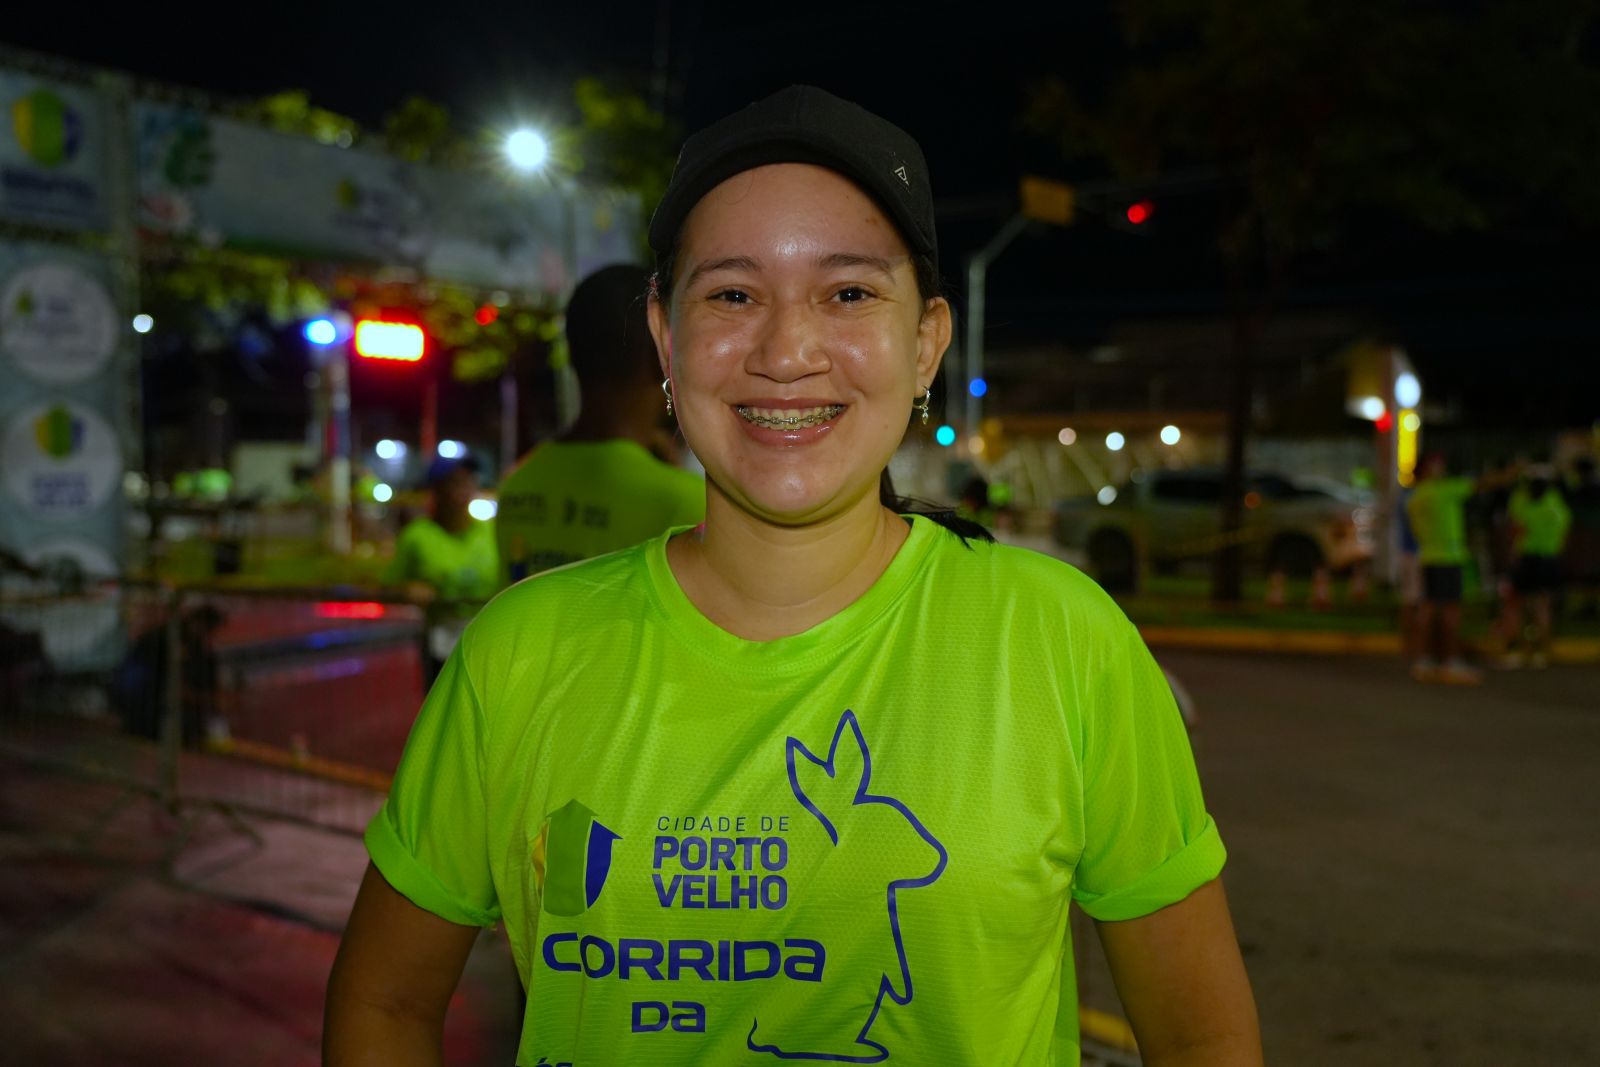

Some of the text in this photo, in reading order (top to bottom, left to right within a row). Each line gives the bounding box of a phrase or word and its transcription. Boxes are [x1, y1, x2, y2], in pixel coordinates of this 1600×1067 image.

[657, 816, 790, 832] CIDADE DE
[652, 835, 788, 871] PORTO
[651, 874, 788, 910] VELHO
